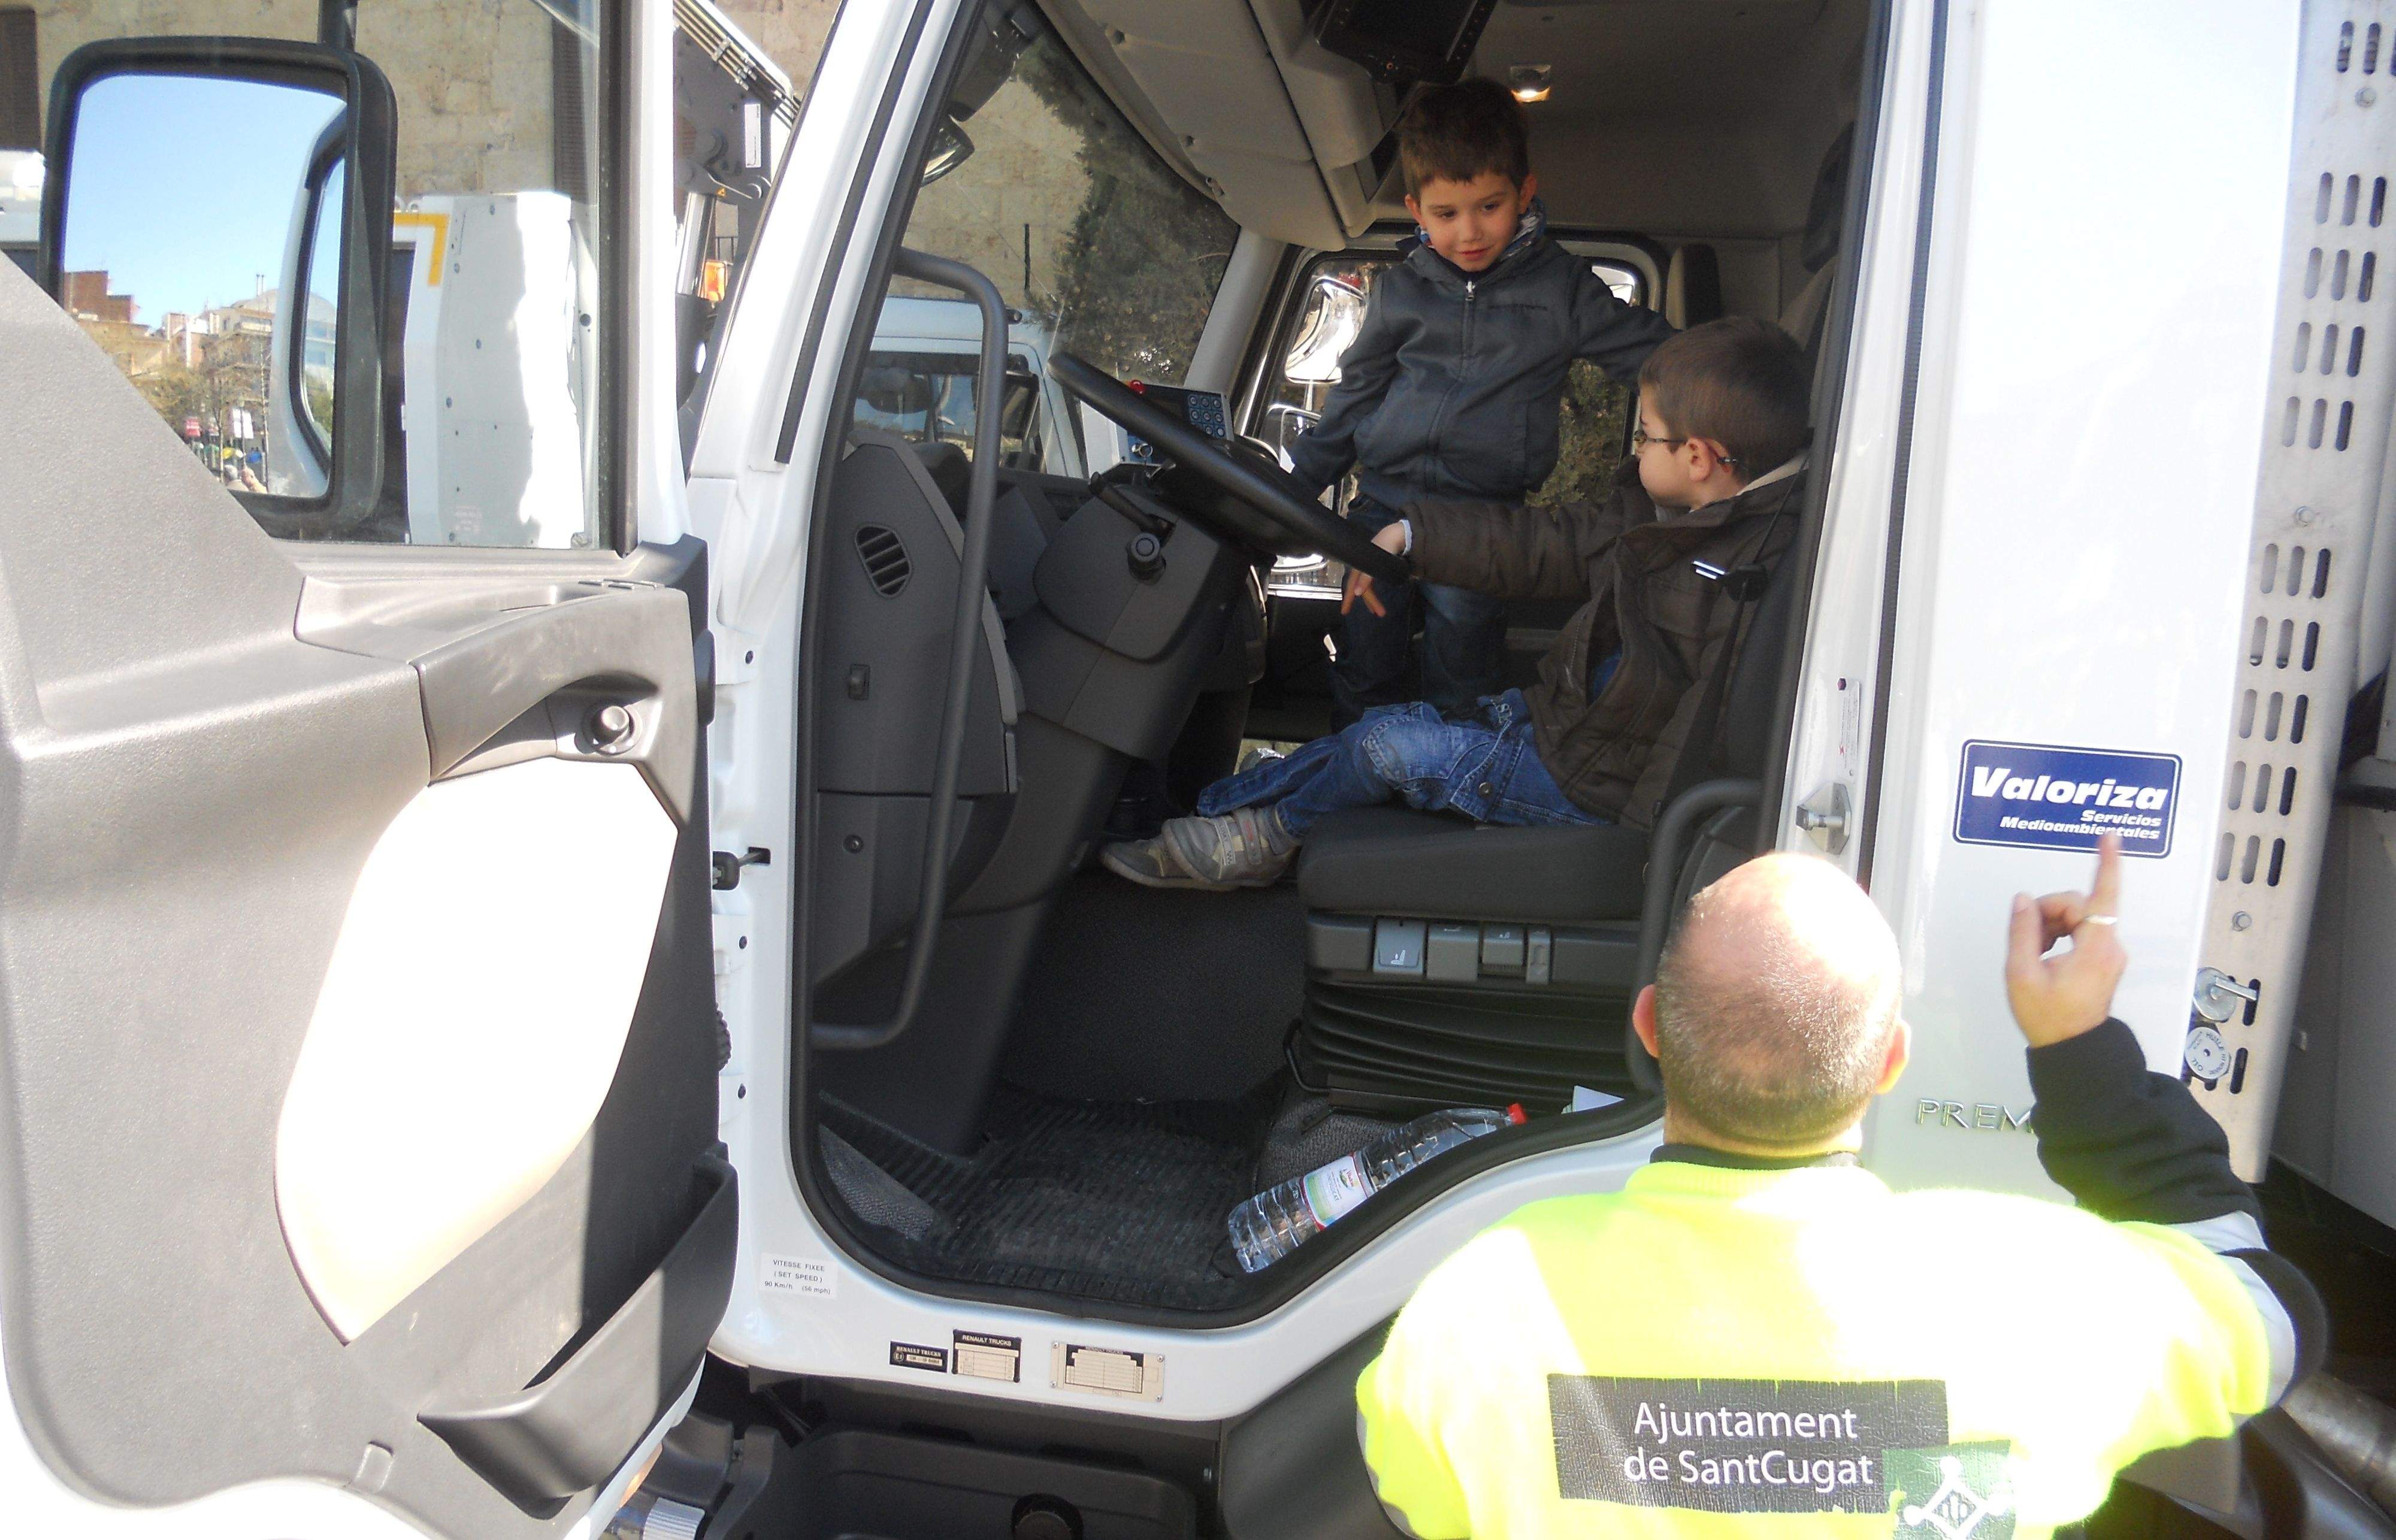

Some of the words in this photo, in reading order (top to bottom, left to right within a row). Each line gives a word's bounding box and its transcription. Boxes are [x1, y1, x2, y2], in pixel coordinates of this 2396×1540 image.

[1971, 767, 2169, 810] Valoriza
[2080, 810, 2161, 827] Servicios
[773, 1259, 801, 1269] VITESSE
[805, 1263, 825, 1272] FIXEE
[962, 1334, 988, 1343] RENAULT
[988, 1338, 1012, 1347] TRUCKS
[921, 1349, 942, 1357] TRUCKS
[1633, 1402, 1857, 1444] Ajuntament
[1624, 1446, 1669, 1482] de
